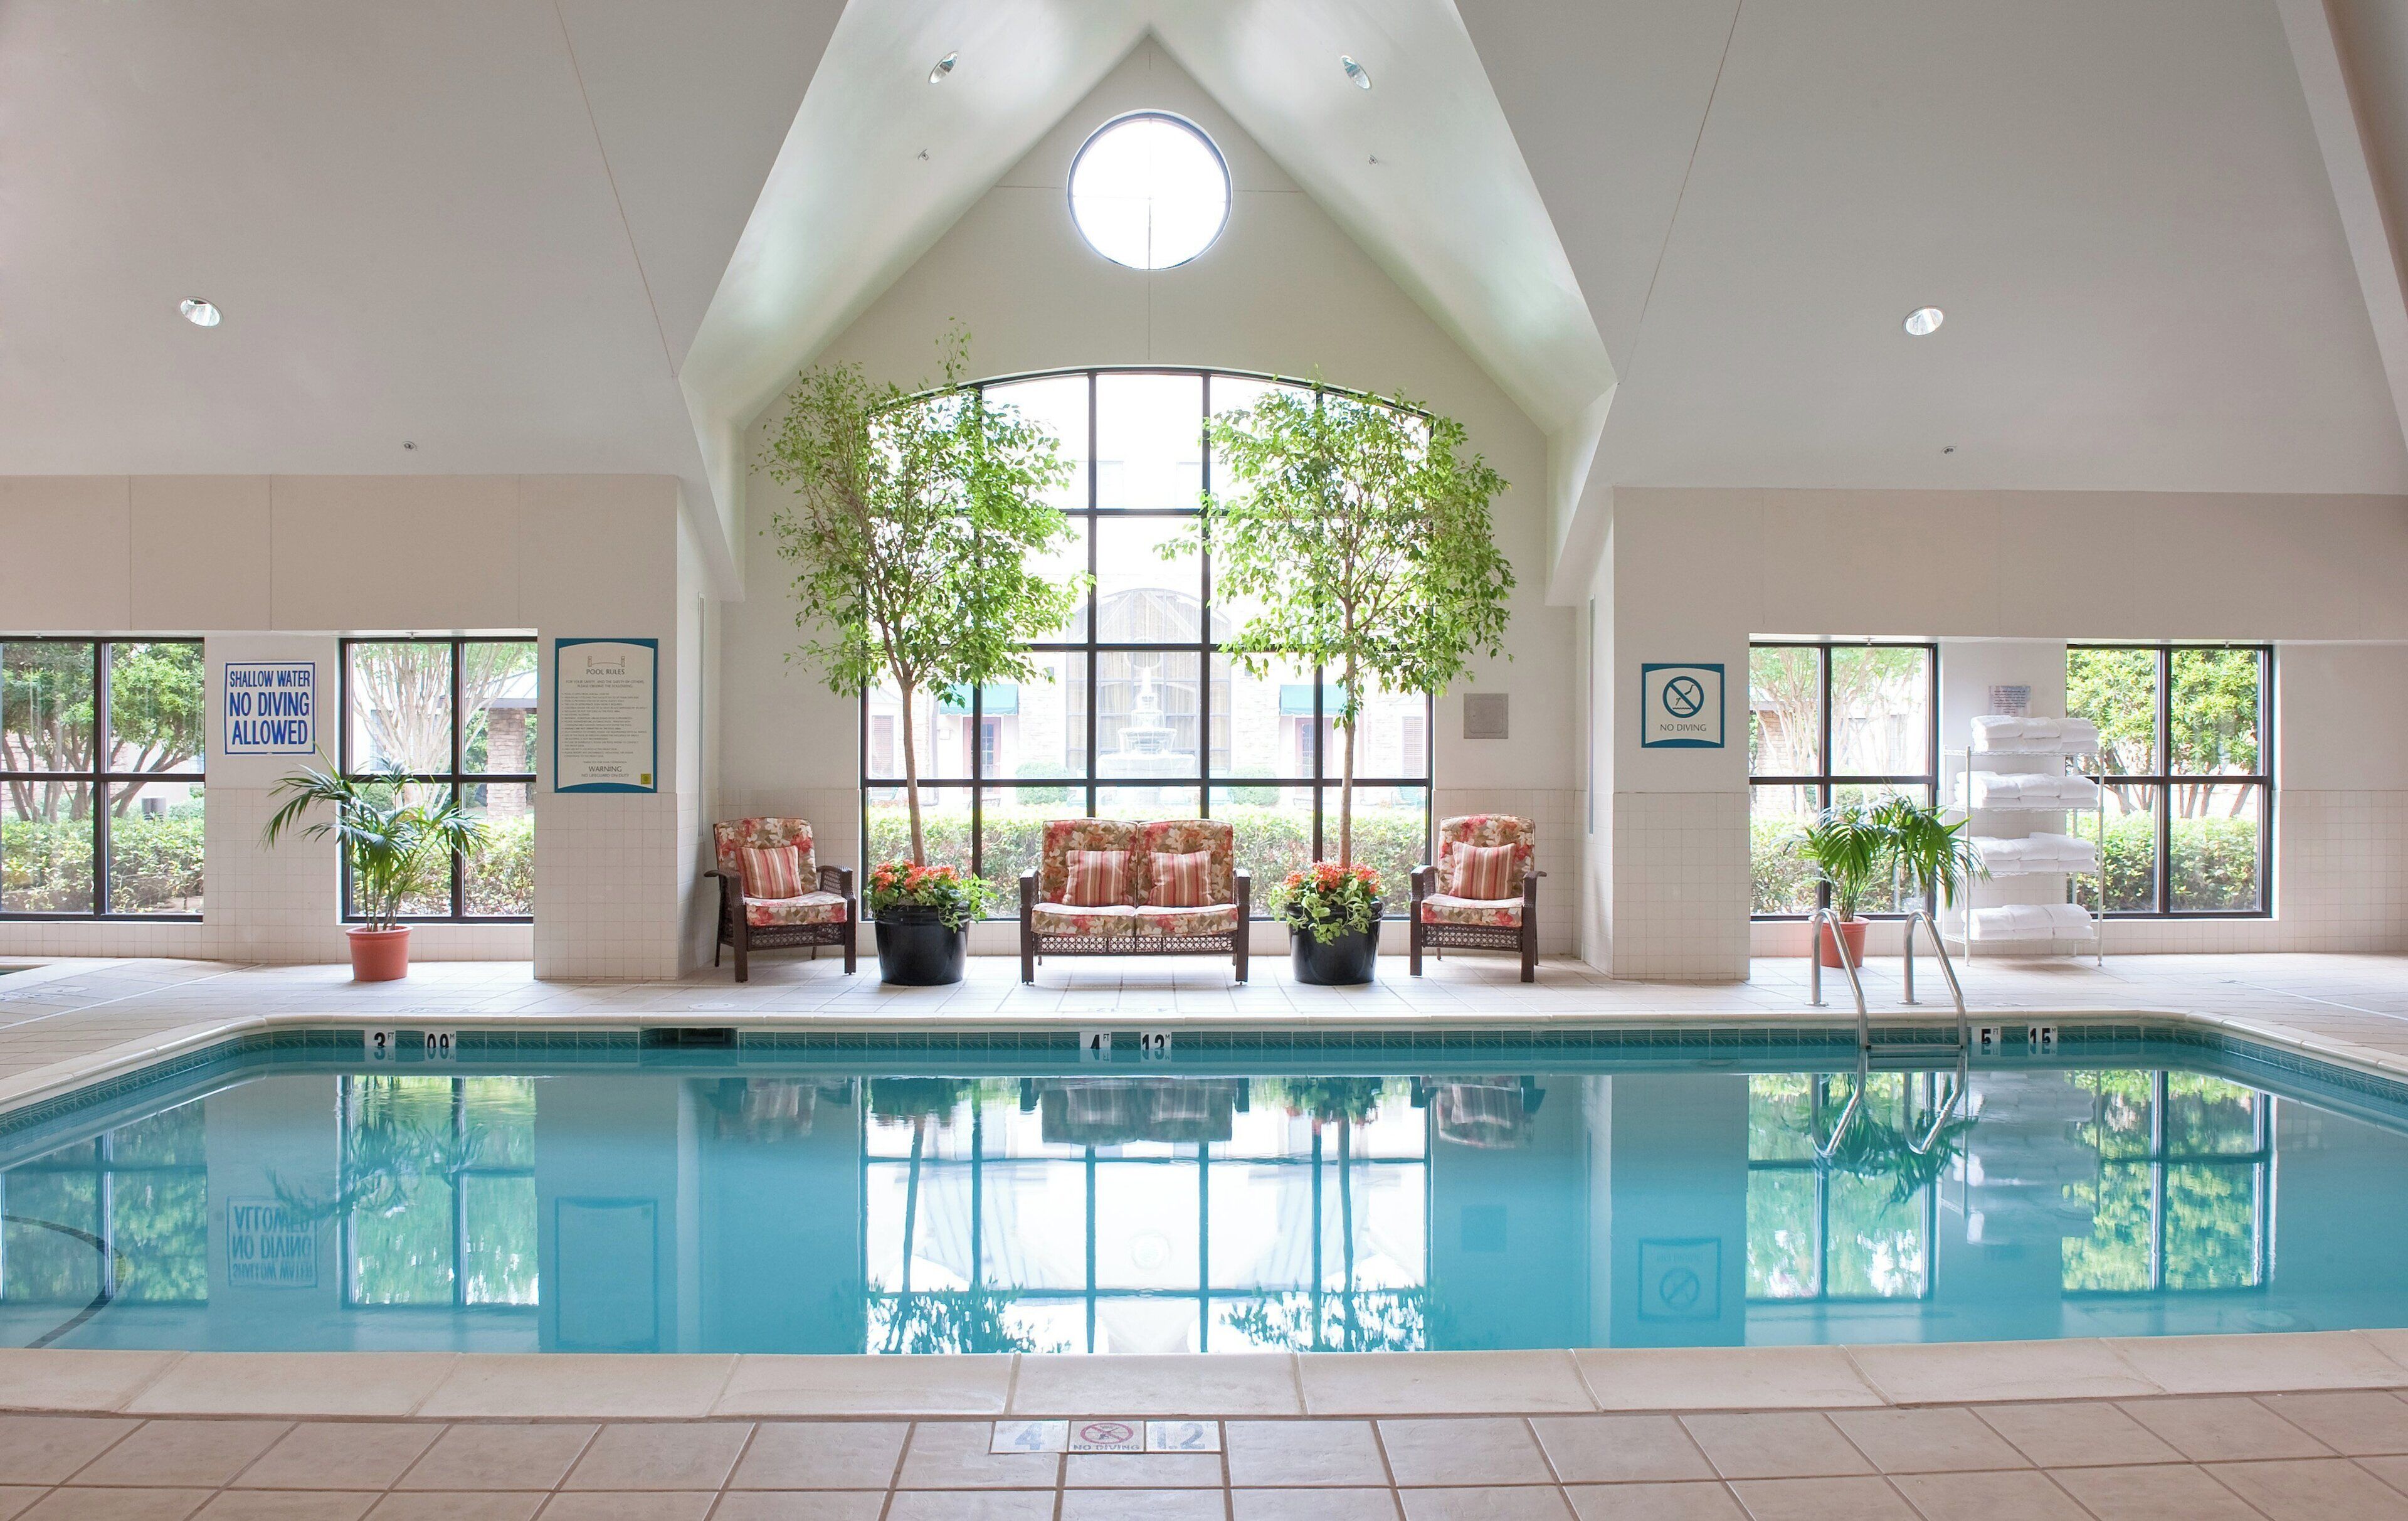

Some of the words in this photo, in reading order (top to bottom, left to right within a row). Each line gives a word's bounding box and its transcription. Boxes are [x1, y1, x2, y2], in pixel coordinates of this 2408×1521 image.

[230, 670, 274, 687] SHALLOW
[277, 670, 311, 687] WATER
[230, 692, 251, 716] NO
[258, 692, 310, 716] DIVING
[232, 720, 308, 745] ALLOWED
[374, 1032, 386, 1049] 3
[388, 1032, 394, 1040] FT
[1090, 1034, 1101, 1050] 4
[1103, 1033, 1109, 1042] FT
[1981, 1028, 1992, 1044] 5
[1015, 1423, 1044, 1450] 4
